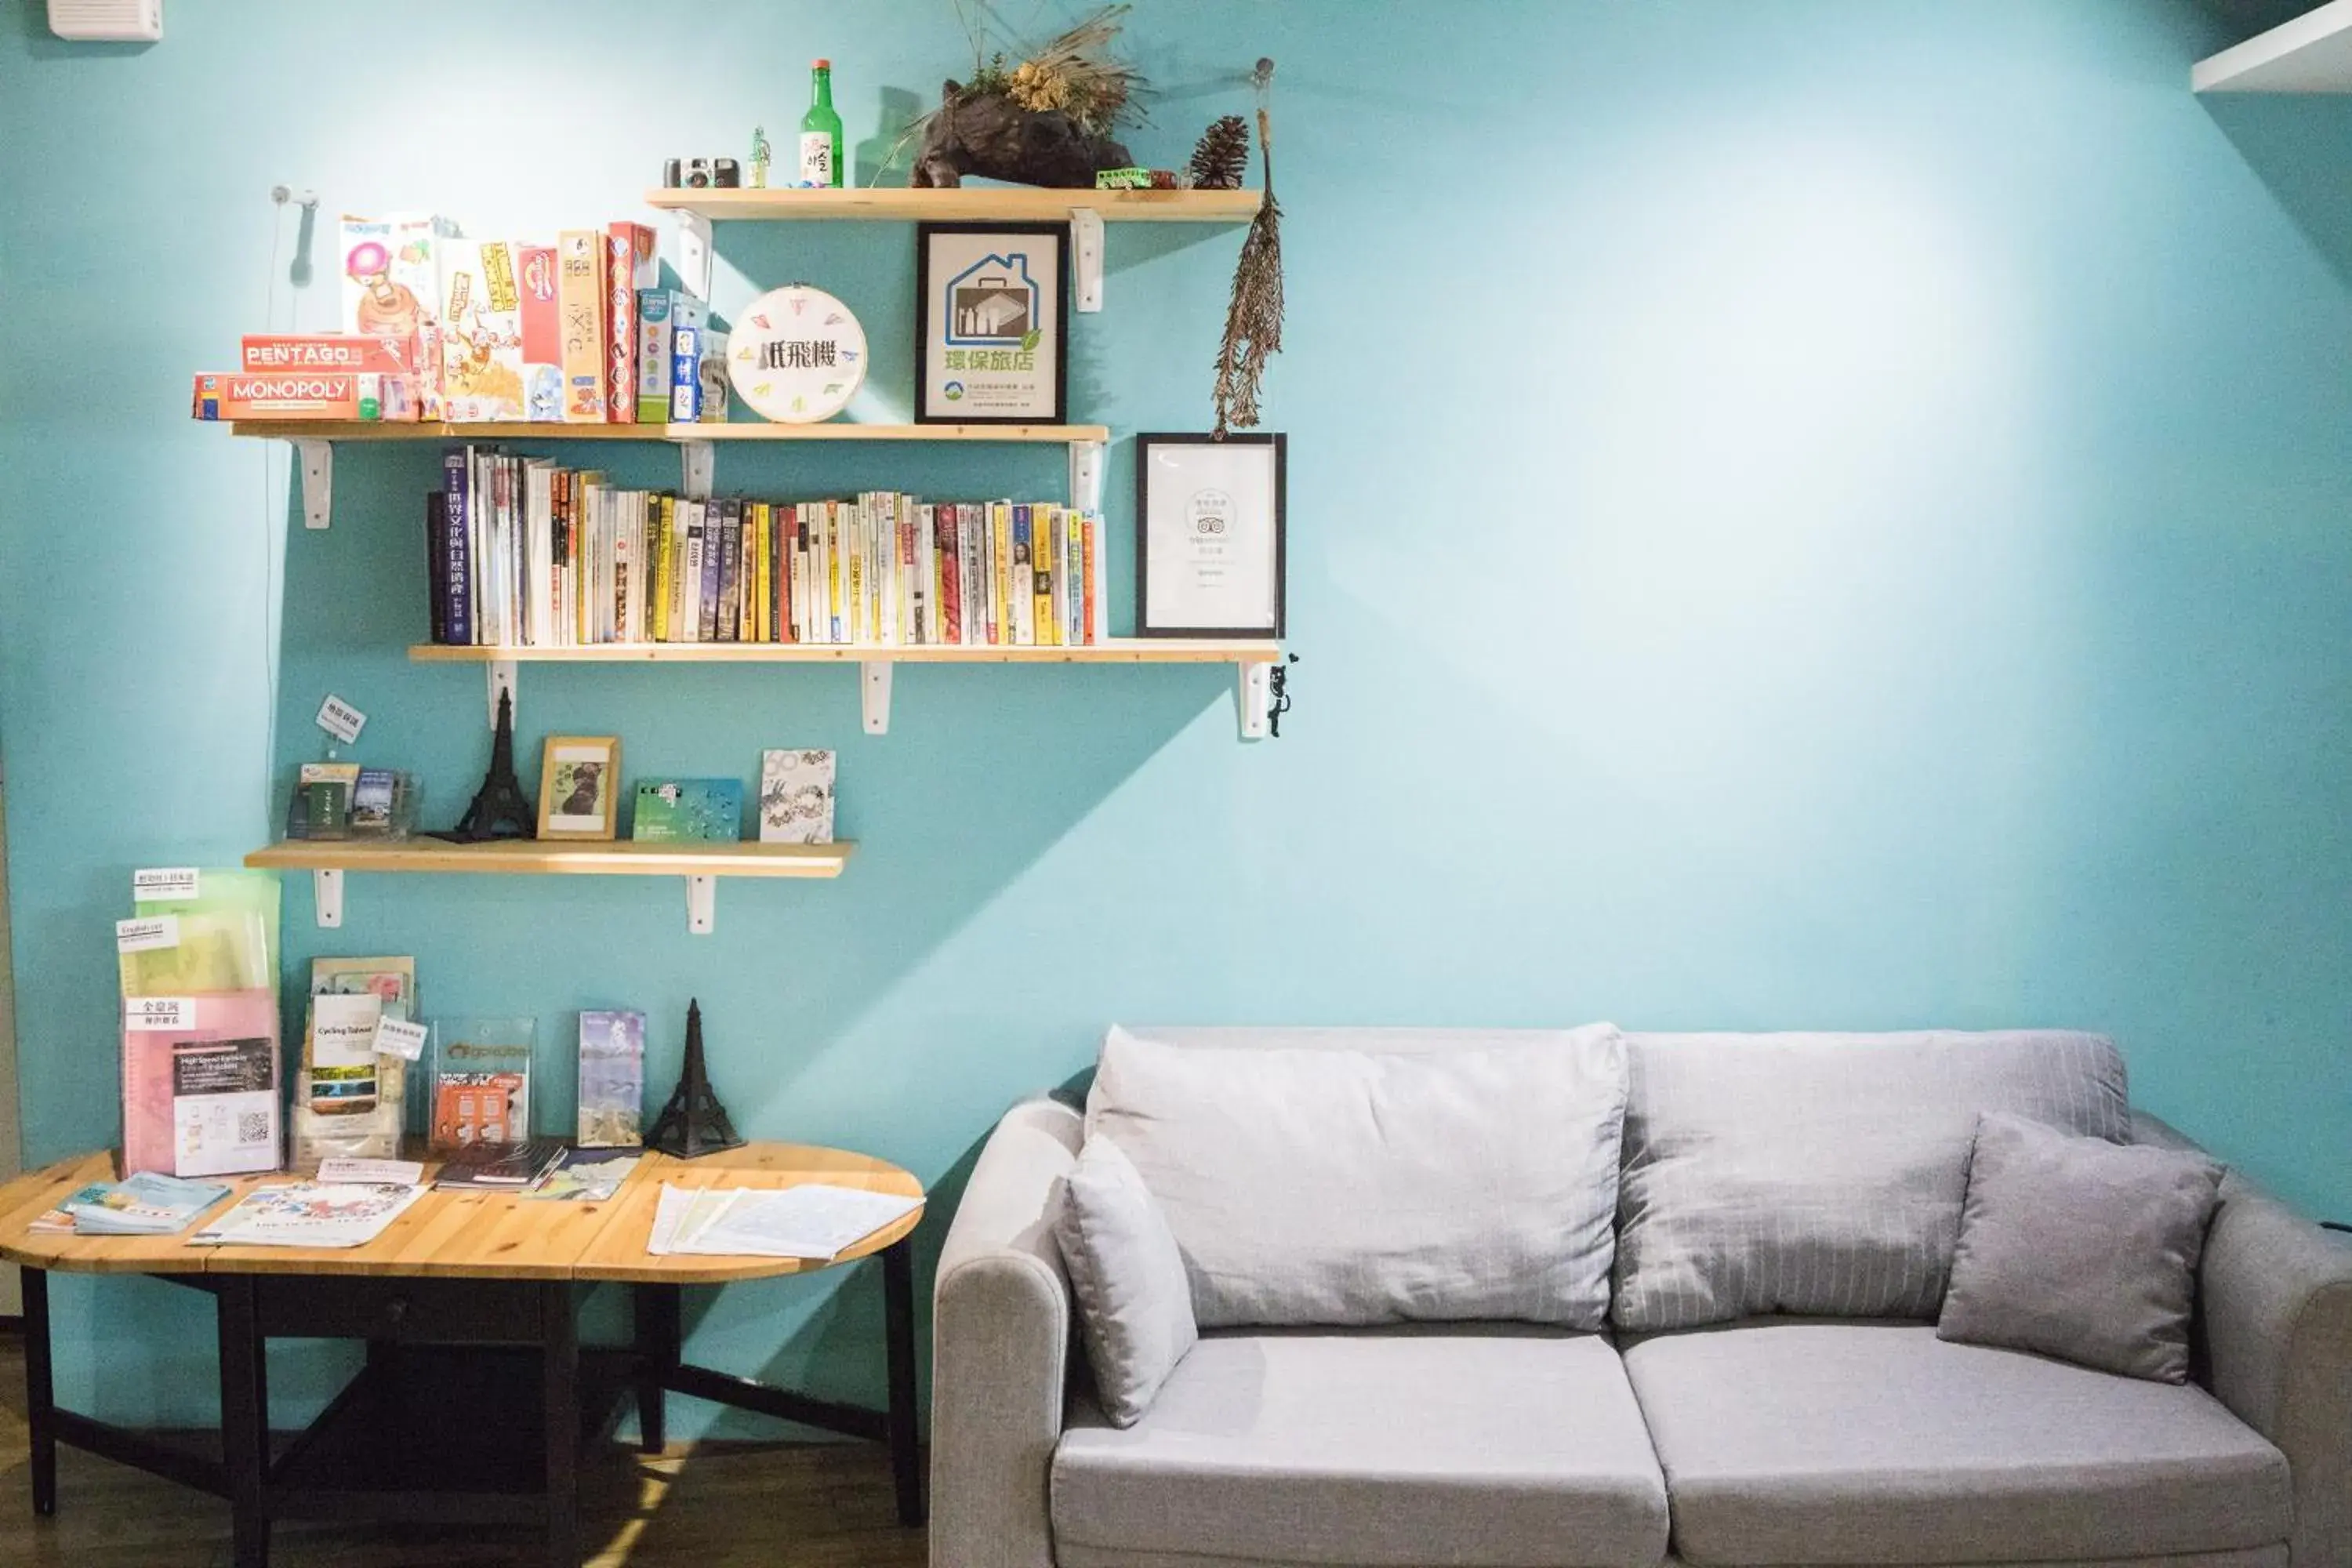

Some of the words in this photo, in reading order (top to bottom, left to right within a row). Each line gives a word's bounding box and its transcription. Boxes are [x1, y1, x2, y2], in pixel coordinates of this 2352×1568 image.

[246, 347, 349, 362] PENTAGO
[945, 350, 1034, 371] 環保旅店
[233, 380, 347, 399] MONOPOLY
[448, 492, 465, 595] 世界文化與自然遺產
[318, 1026, 347, 1036] Cycling
[347, 1025, 372, 1035] Taiwan
